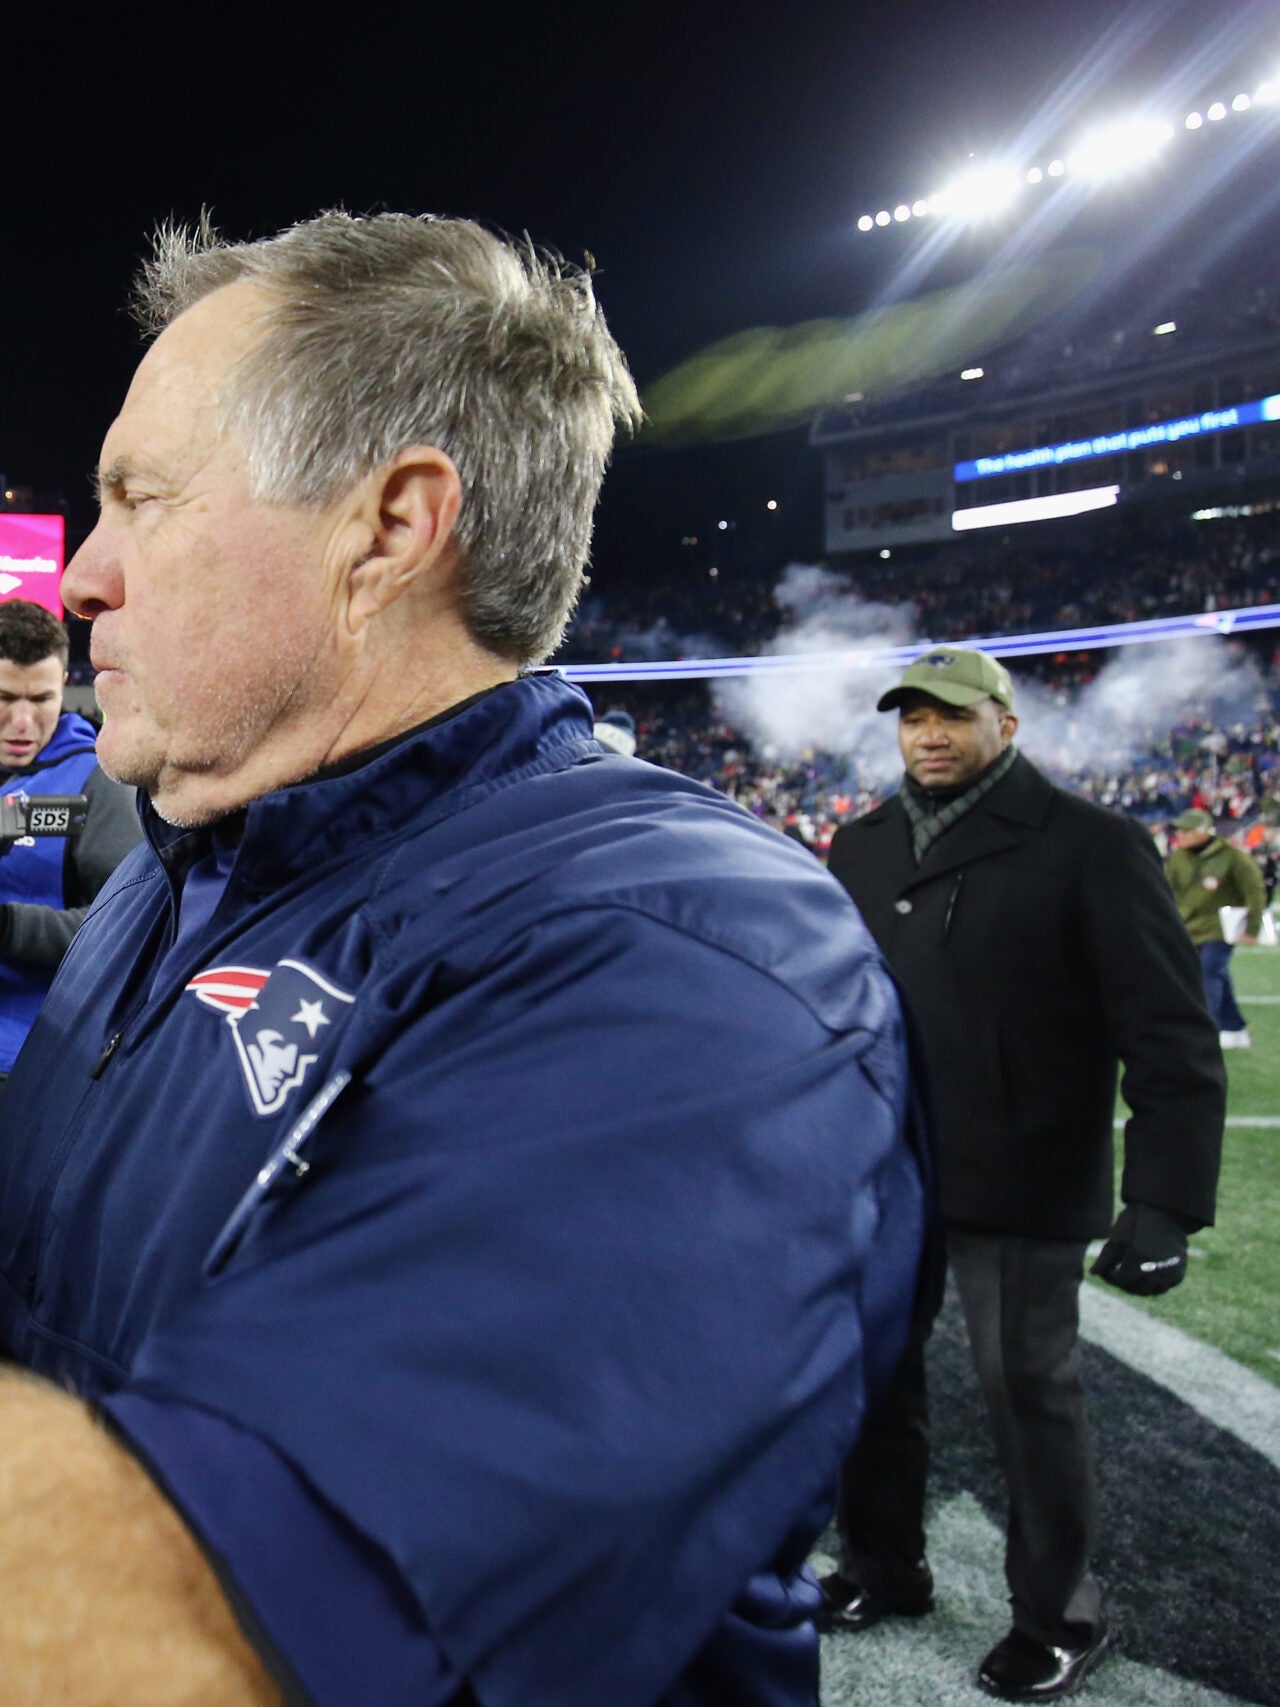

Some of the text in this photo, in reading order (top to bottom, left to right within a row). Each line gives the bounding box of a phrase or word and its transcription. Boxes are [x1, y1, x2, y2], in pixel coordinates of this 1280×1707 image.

[1004, 447, 1055, 471] health
[1054, 441, 1092, 464] plan
[1091, 432, 1128, 455] that
[1166, 417, 1201, 442] you
[32, 812, 67, 827] SDS
